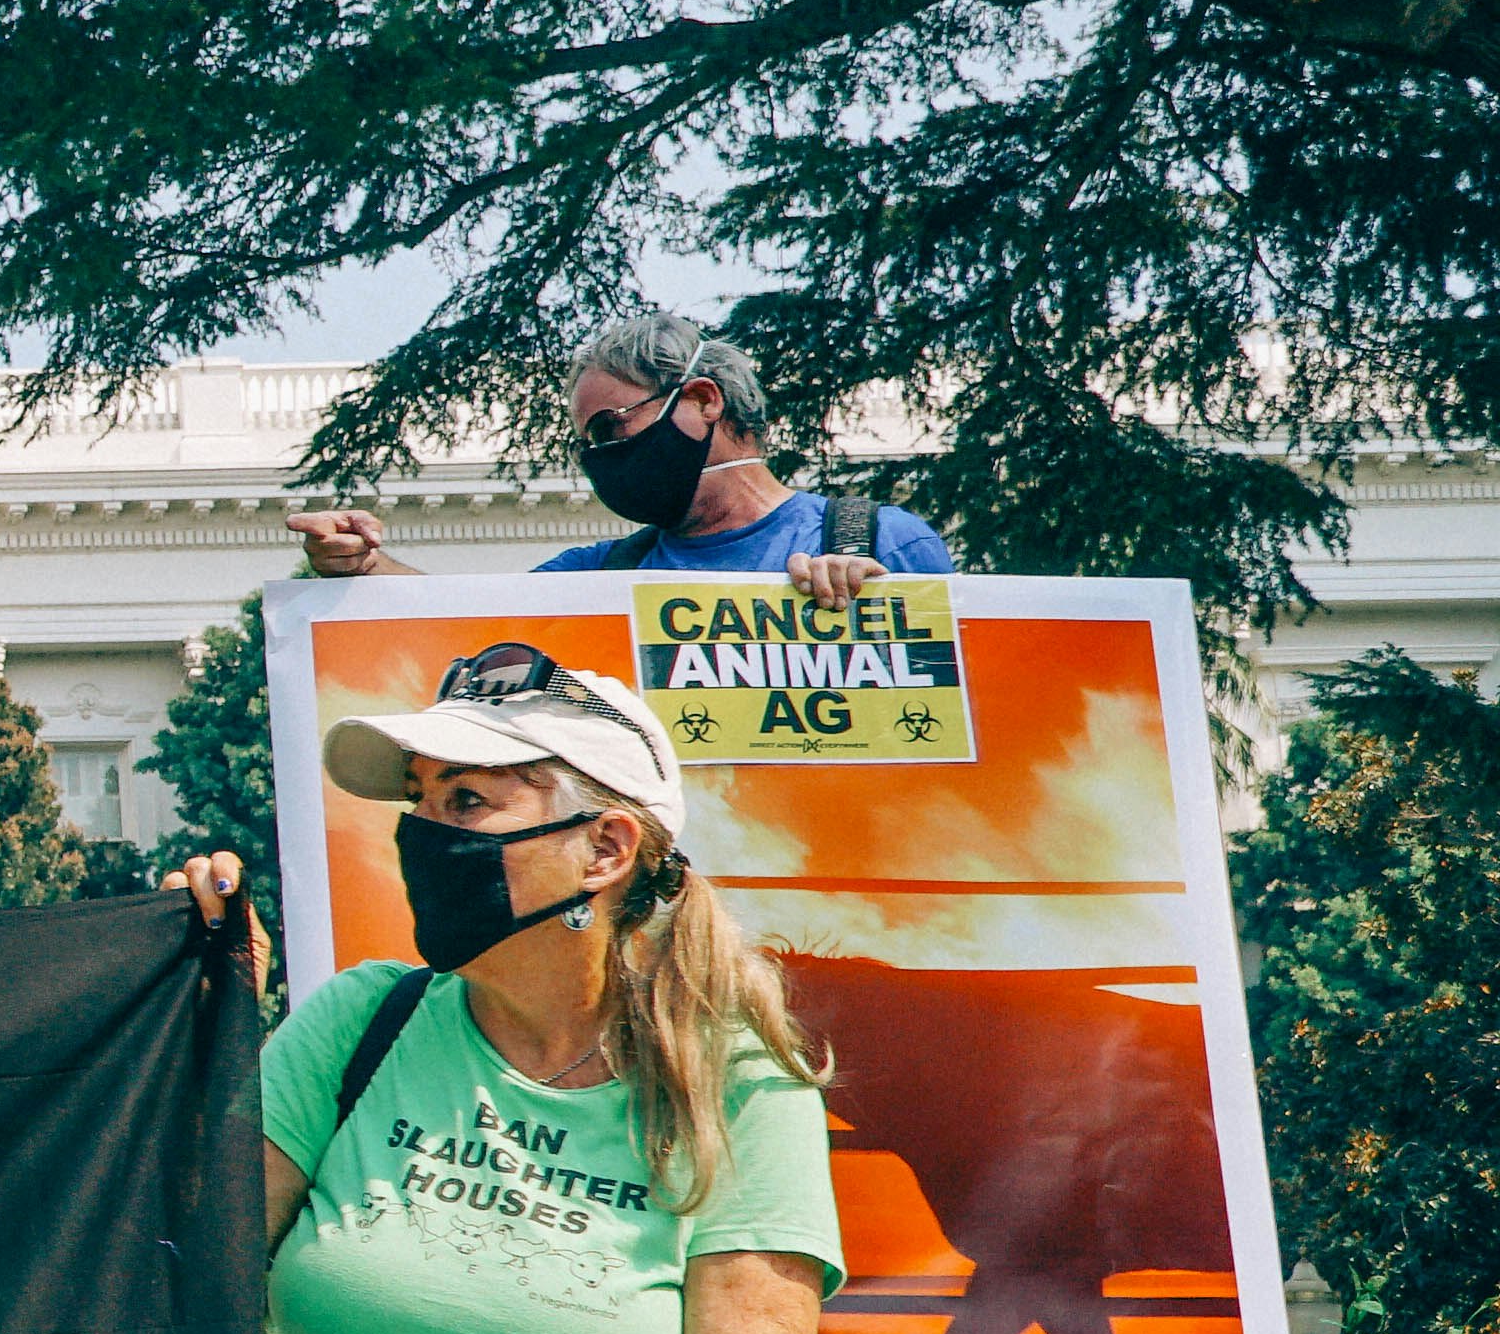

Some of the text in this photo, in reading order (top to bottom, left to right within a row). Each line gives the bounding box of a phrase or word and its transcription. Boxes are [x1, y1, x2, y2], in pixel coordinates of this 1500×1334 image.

[659, 597, 932, 642] CANCEL
[667, 643, 935, 688] ANIMAL
[759, 690, 852, 735] AG
[474, 1101, 569, 1157] BAN
[387, 1118, 650, 1212] SLAUGHTER
[401, 1163, 591, 1235] HOUSES
